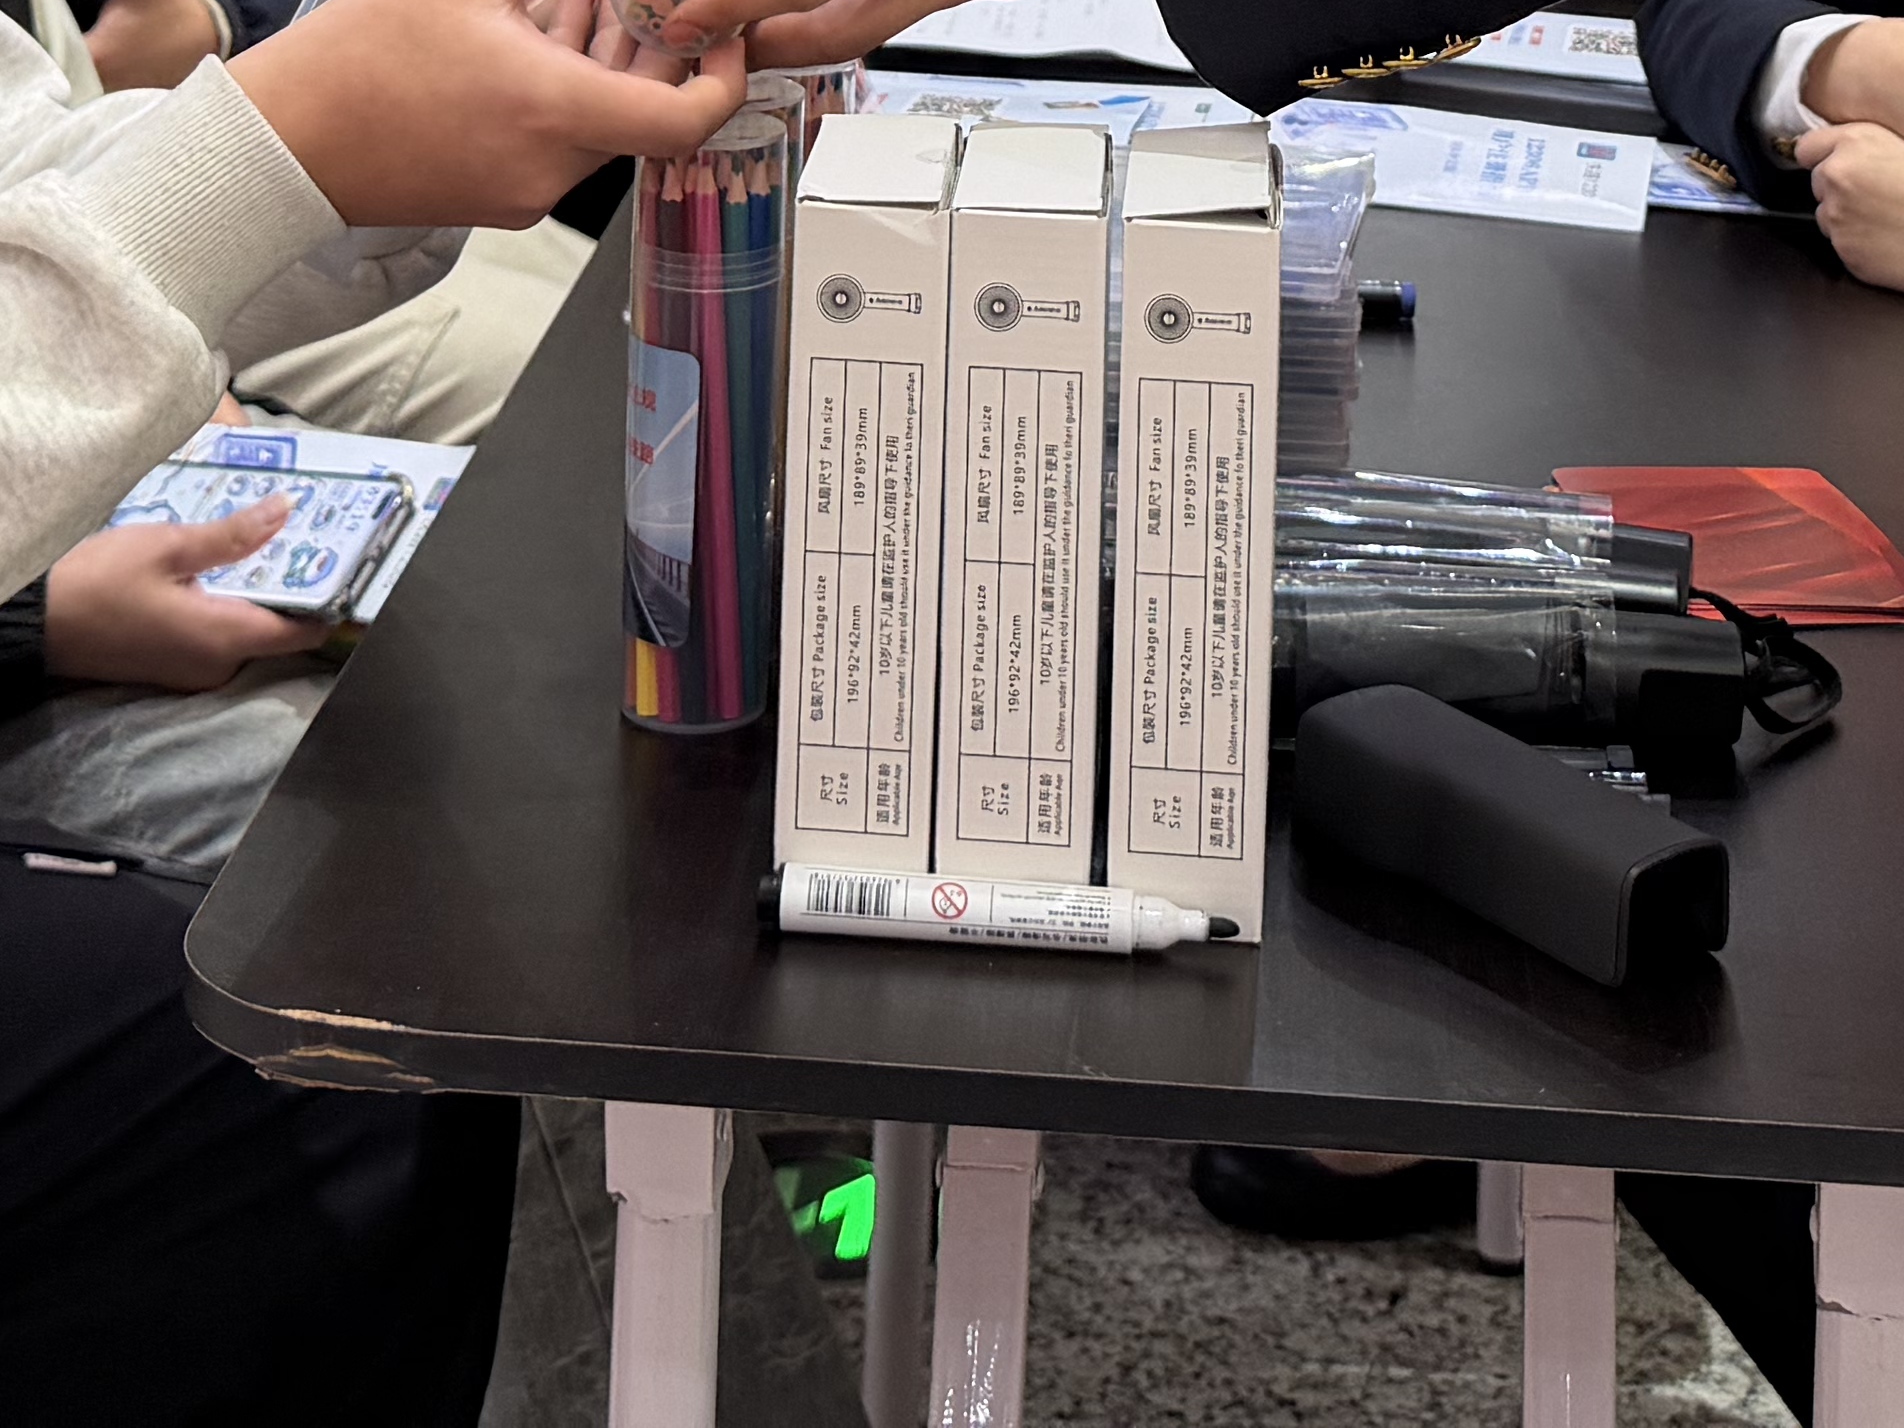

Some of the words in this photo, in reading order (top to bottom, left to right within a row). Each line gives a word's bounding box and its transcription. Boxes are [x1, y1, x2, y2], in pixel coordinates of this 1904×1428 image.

[821, 396, 834, 423] size
[979, 405, 992, 432] size
[820, 426, 833, 450] Fan
[1150, 417, 1163, 444] size
[979, 435, 992, 459] Fan
[1149, 447, 1162, 471] Fan
[815, 574, 826, 601] size
[975, 584, 986, 611] size
[1146, 597, 1157, 624] size
[812, 604, 828, 662] Package
[972, 614, 988, 672] Package
[1143, 627, 1159, 685] Package
[820, 773, 833, 802] 尺寸
[836, 771, 848, 805] Size
[981, 783, 994, 812] 尺寸
[997, 781, 1009, 815] Size
[1153, 796, 1166, 825] 尺寸
[1169, 794, 1181, 828] Size
